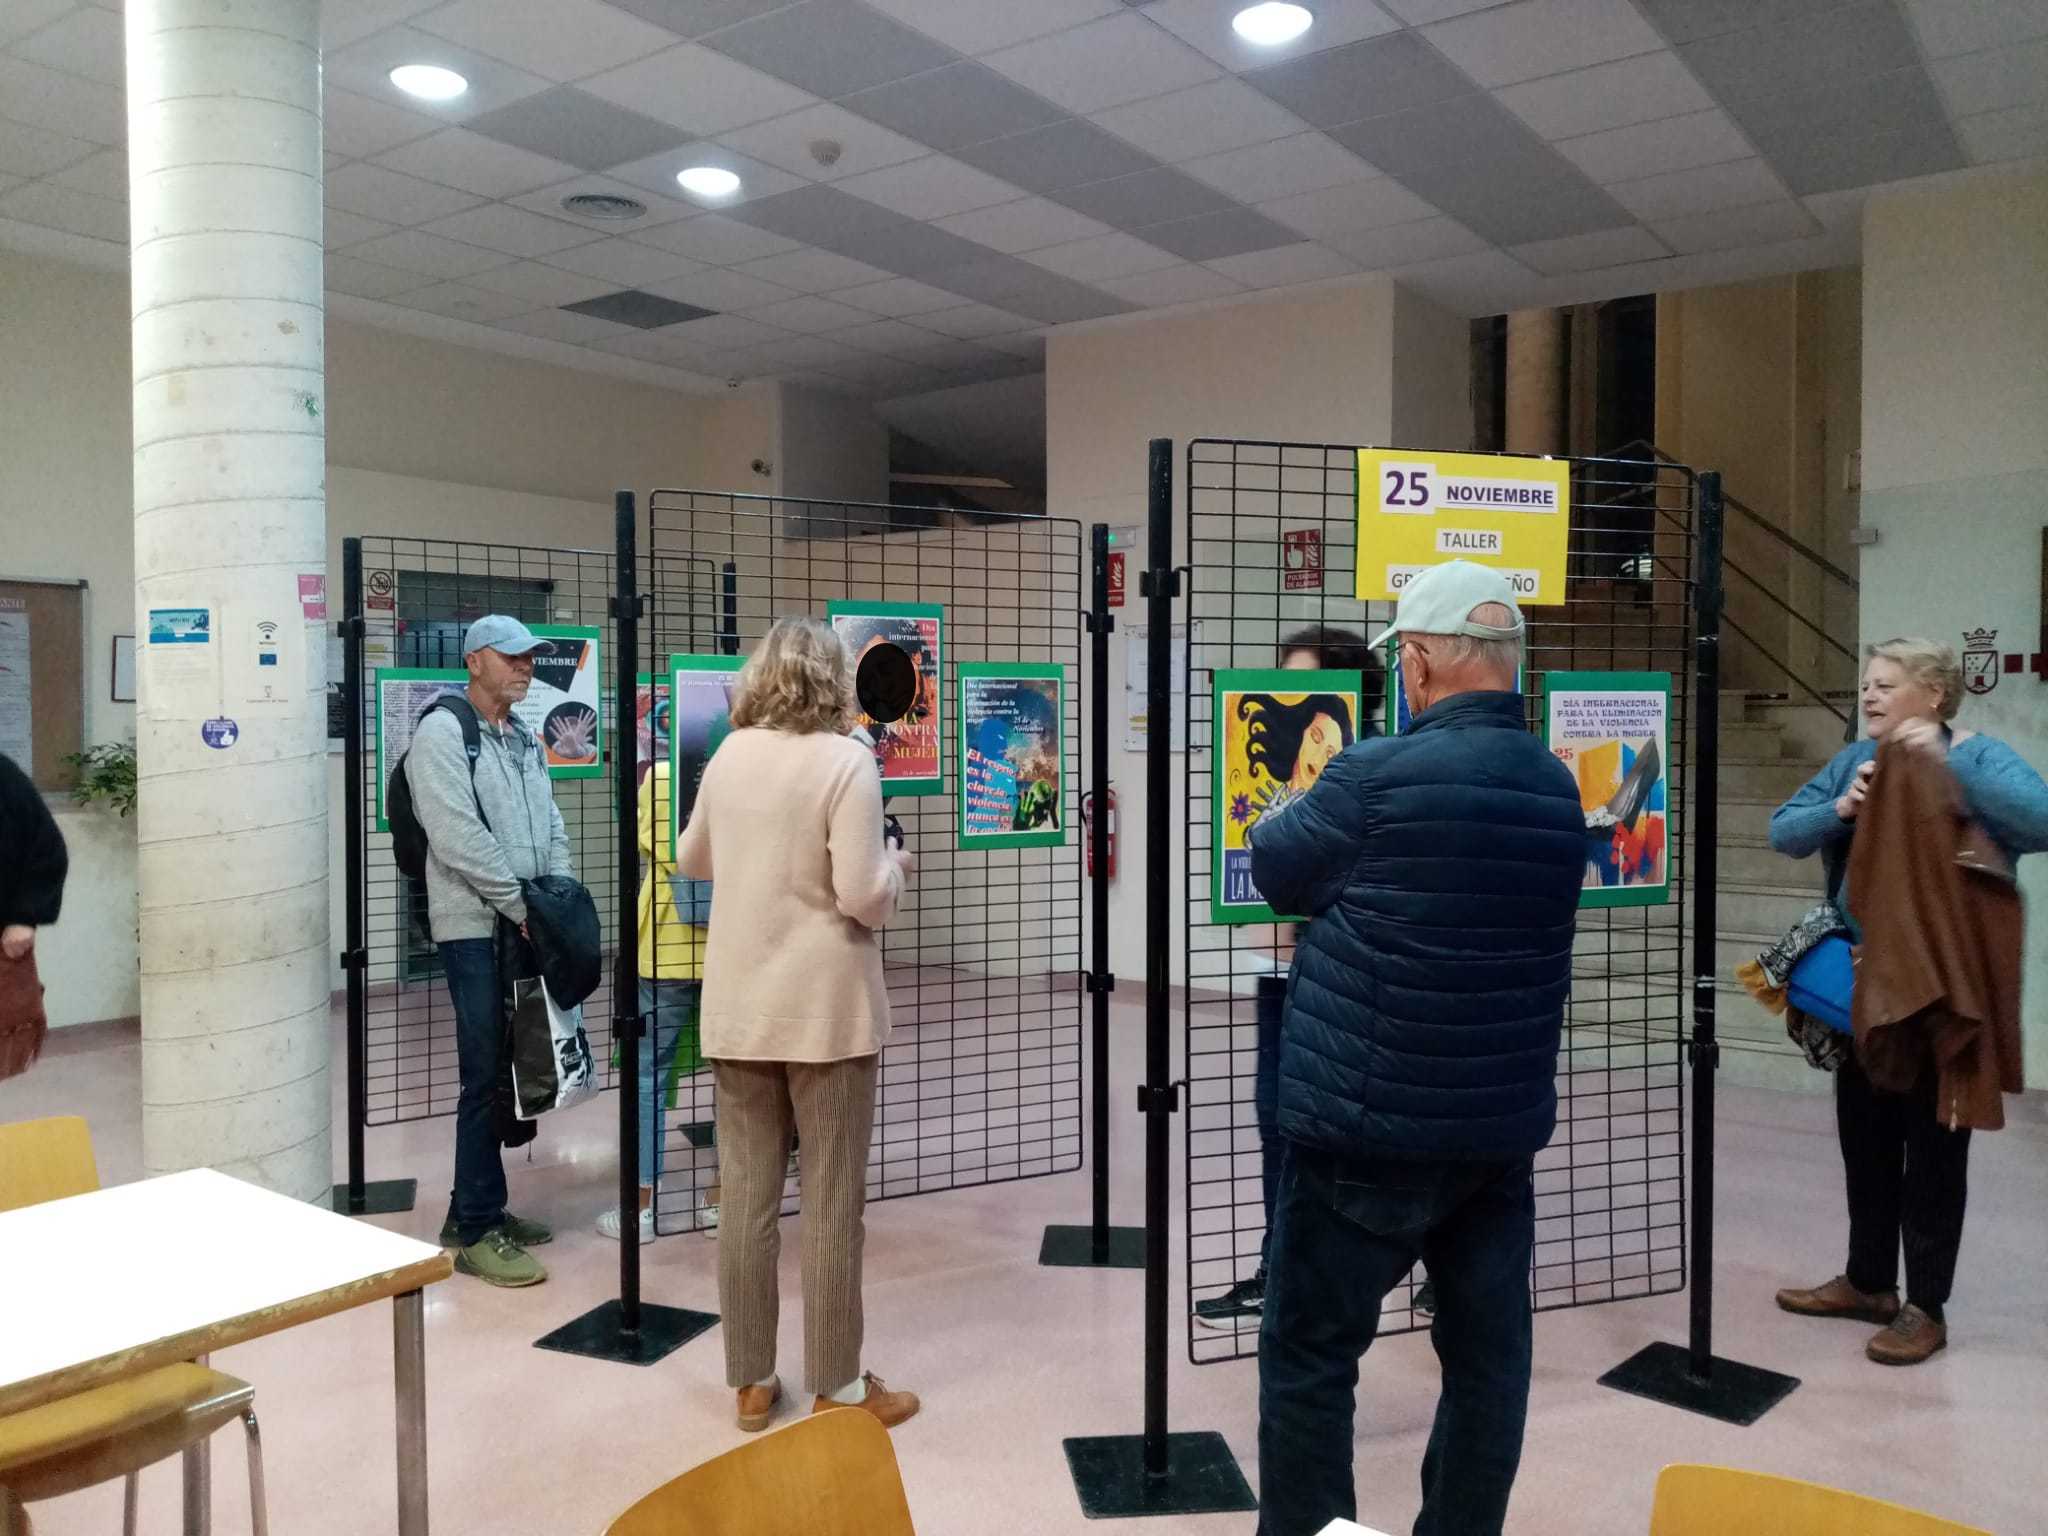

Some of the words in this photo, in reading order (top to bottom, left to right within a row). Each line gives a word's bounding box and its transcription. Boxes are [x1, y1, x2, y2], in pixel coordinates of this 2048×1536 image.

[1385, 470, 1430, 506] 25
[1446, 486, 1554, 504] NOVIEMBRE
[1443, 532, 1498, 549] TALLER
[532, 657, 577, 666] VIEMBRE
[1557, 710, 1584, 718] PARA
[1587, 710, 1599, 718] LA
[1566, 719, 1579, 727] DE
[1582, 719, 1595, 727] LA
[1600, 719, 1649, 727] VIOLENCIA
[1607, 730, 1620, 738] LA
[1232, 872, 1244, 900] LA
